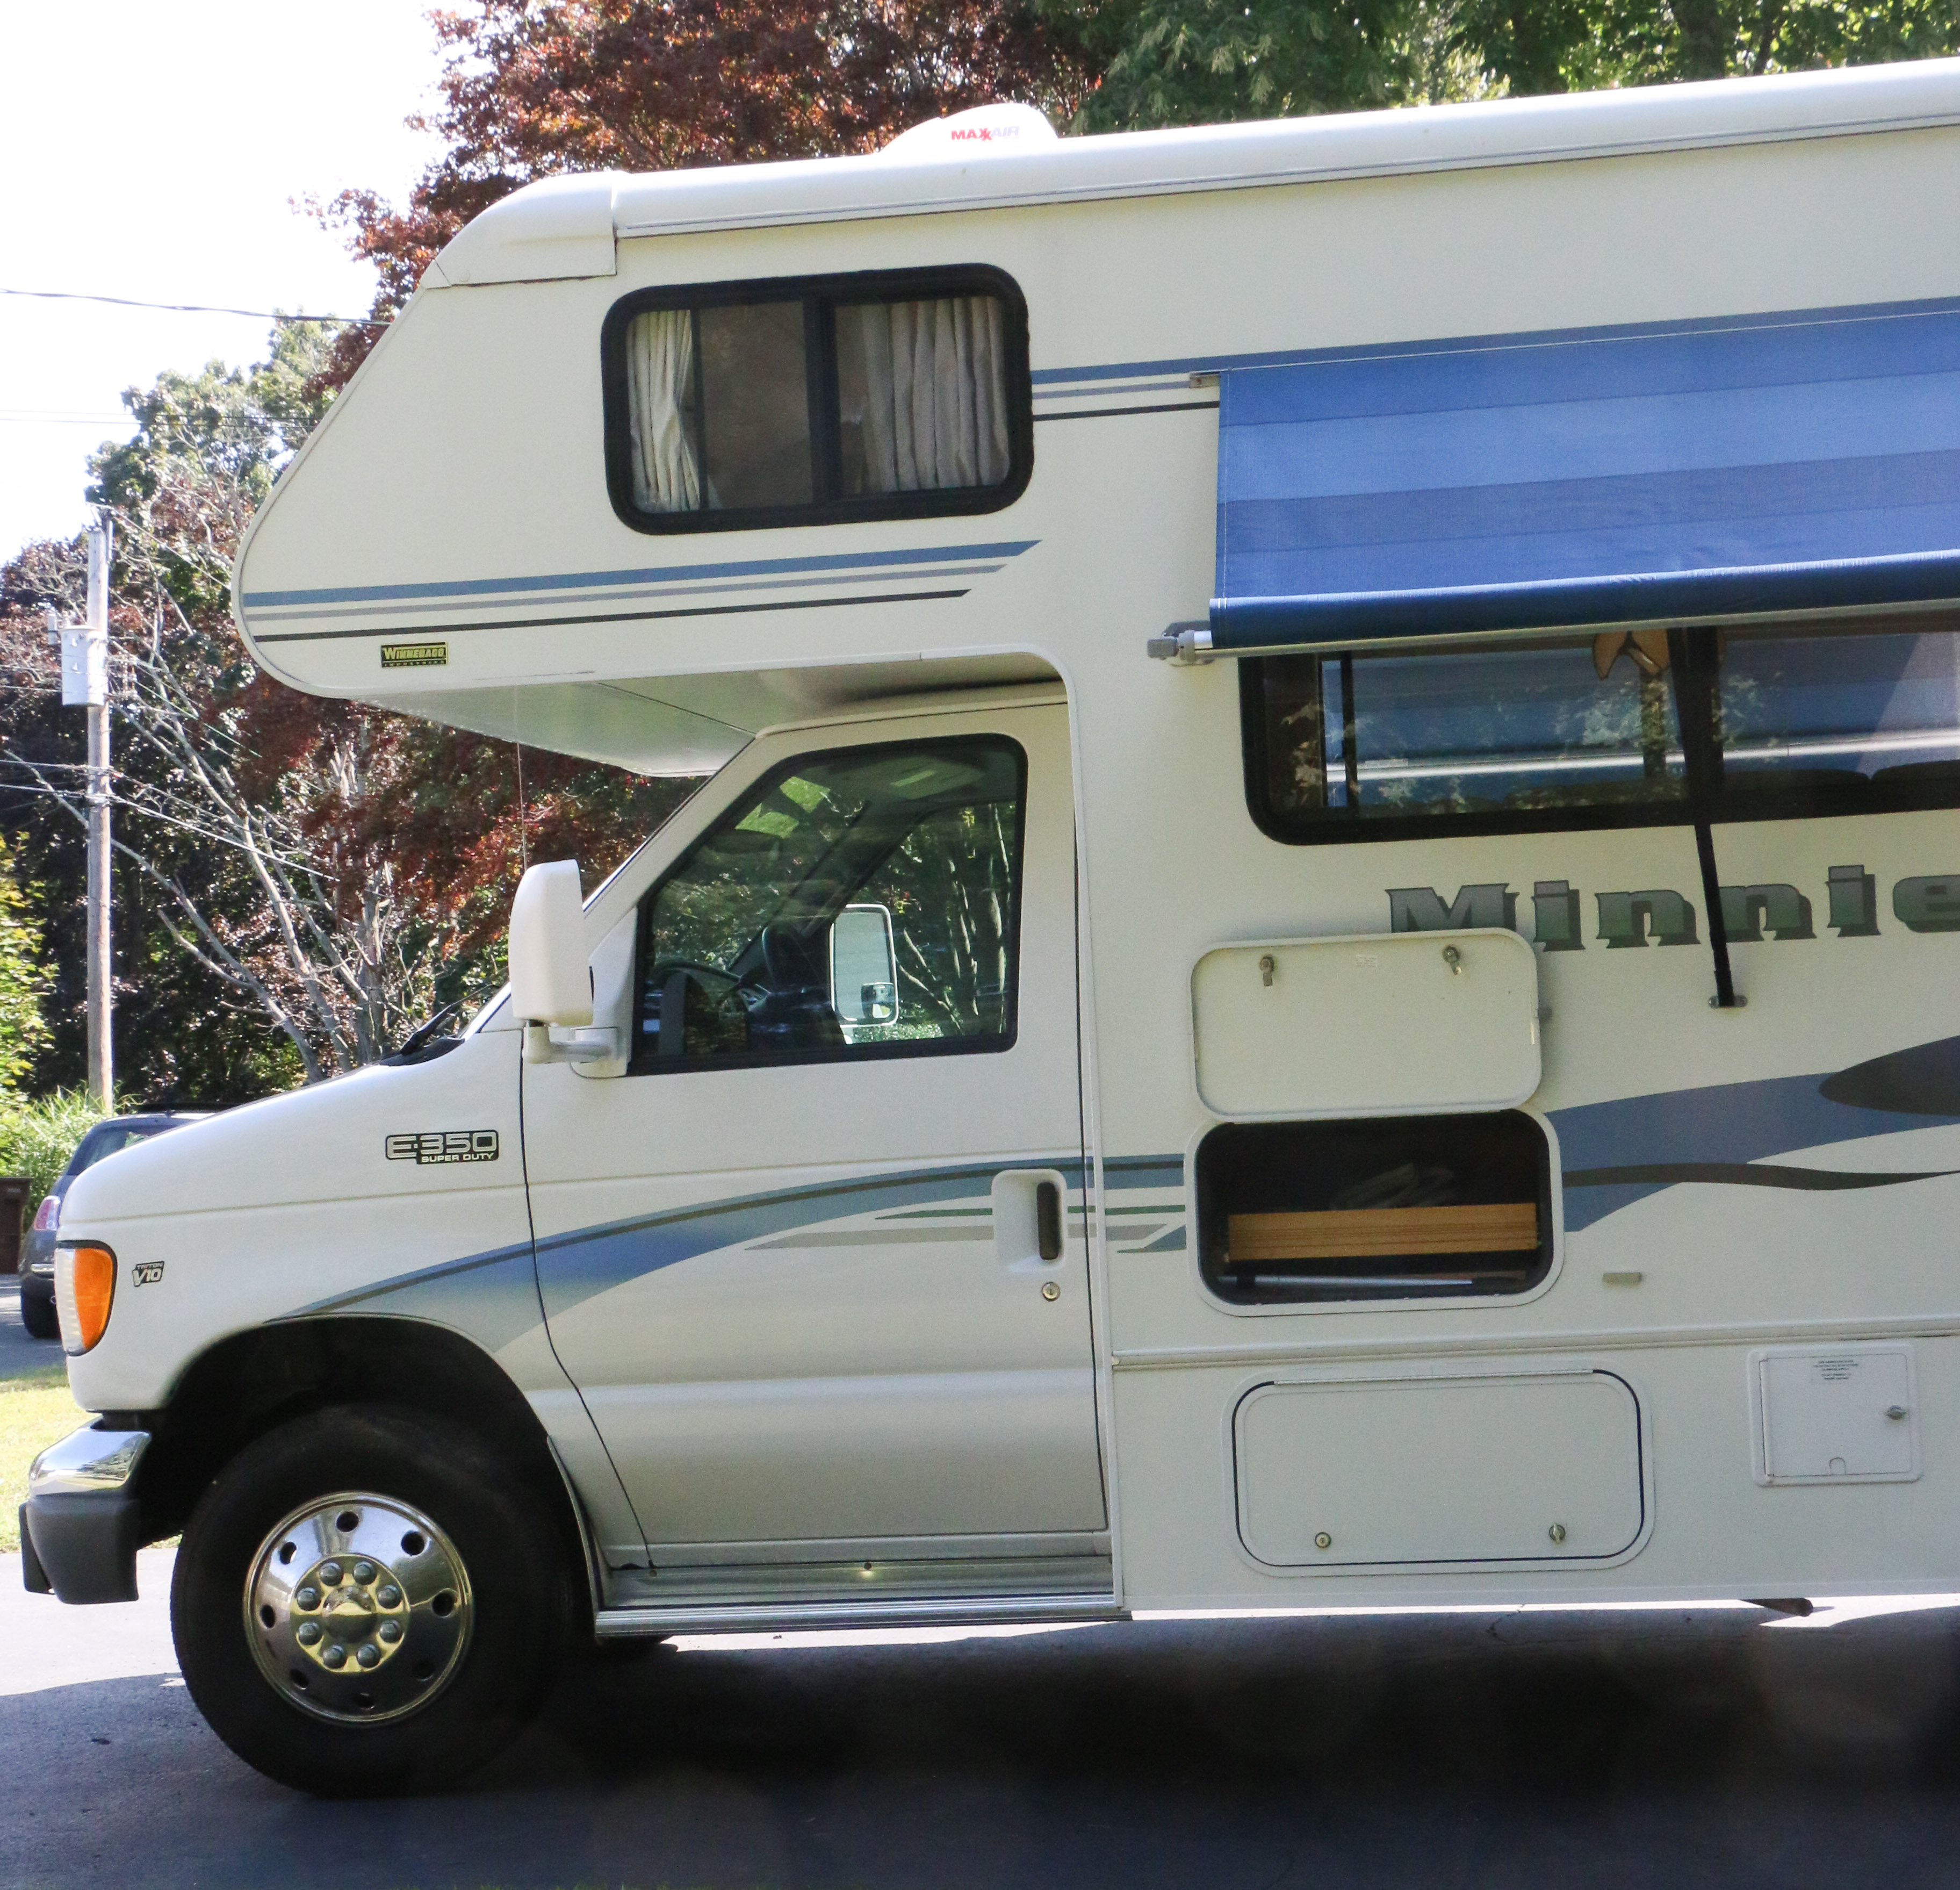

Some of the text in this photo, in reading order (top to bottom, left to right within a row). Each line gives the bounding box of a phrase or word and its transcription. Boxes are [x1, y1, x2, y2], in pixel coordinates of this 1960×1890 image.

[382, 647, 444, 660] WINNEBAGO
[421, 1153, 494, 1163] SUPER DUTY
[133, 1268, 162, 1286] V10
